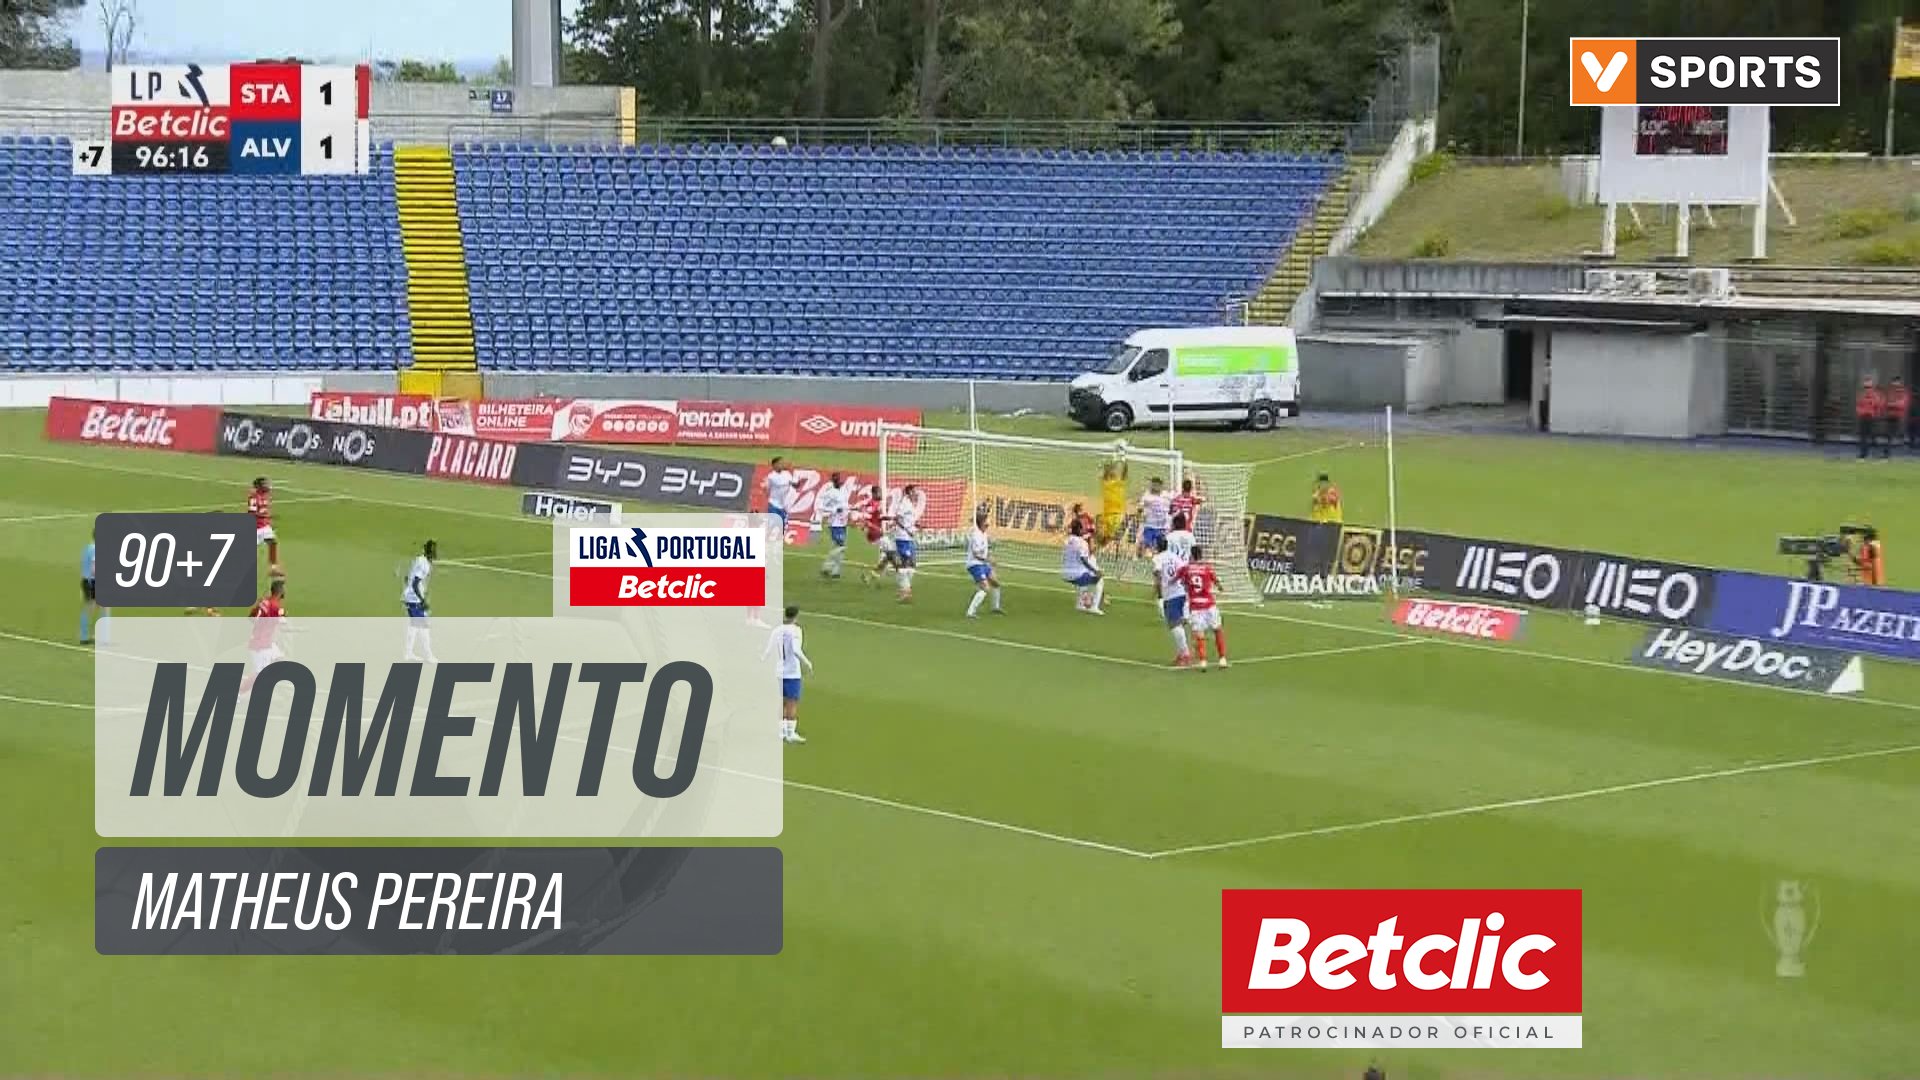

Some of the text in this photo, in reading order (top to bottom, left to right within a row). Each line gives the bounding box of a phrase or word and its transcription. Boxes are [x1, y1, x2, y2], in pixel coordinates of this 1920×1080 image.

[81, 406, 176, 445] Betclic
[477, 416, 528, 428] ONLINE
[478, 403, 554, 416] BILHETEIRA
[678, 408, 773, 430] renata.pt
[223, 420, 263, 450] NOS
[276, 424, 319, 457] NOS
[332, 430, 375, 462] NOS
[427, 436, 518, 480] PLACARD
[567, 456, 646, 488] BYD
[660, 467, 743, 498] BYD
[536, 496, 597, 521] Haier
[1255, 532, 1297, 557] ESC
[1456, 546, 1561, 600] MEO
[1585, 560, 1698, 619] MEO
[1407, 602, 1504, 638] Betclic
[1769, 581, 1840, 638] JP
[1644, 627, 1810, 680] HeyDoc
